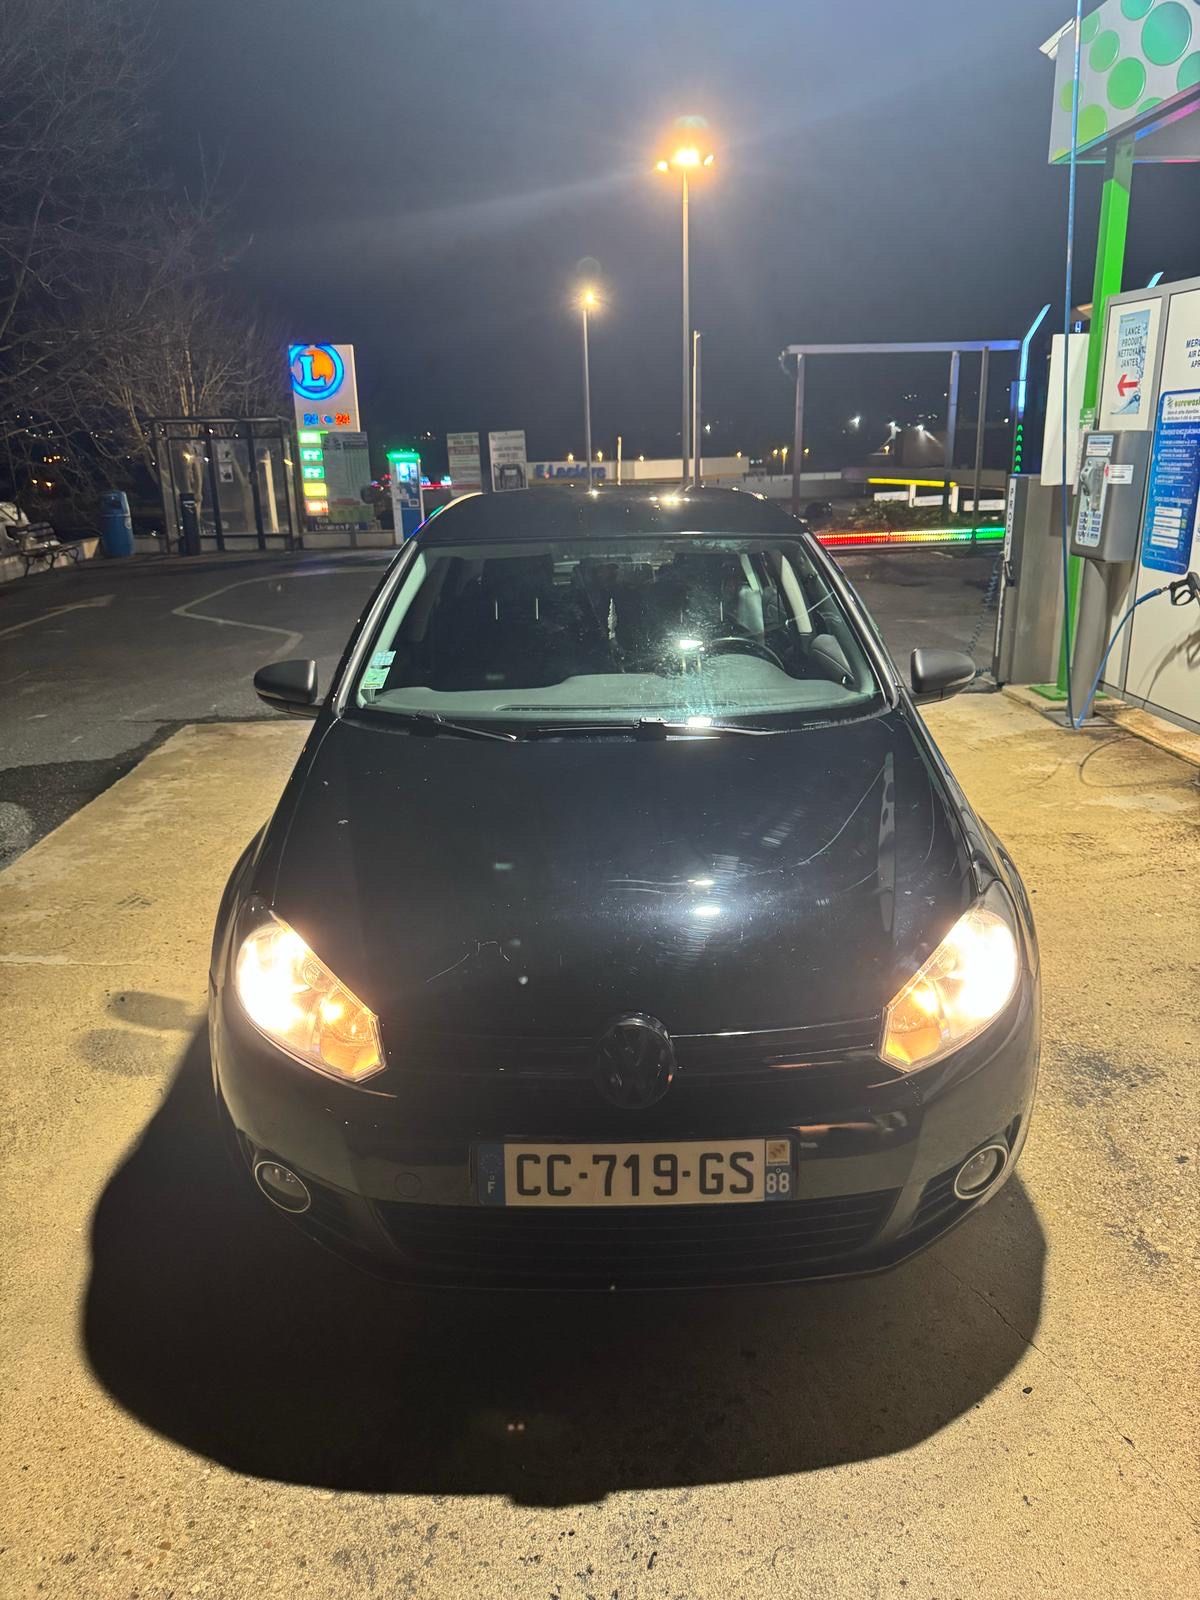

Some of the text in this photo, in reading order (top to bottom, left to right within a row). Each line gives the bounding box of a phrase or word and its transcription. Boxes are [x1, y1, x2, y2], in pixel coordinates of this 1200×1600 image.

[1125, 325, 1141, 336] LANCE
[1120, 357, 1139, 368] JANTES
[516, 1151, 754, 1197] CC-719-GS
[487, 1181, 496, 1194] F
[766, 1172, 790, 1194] 88
